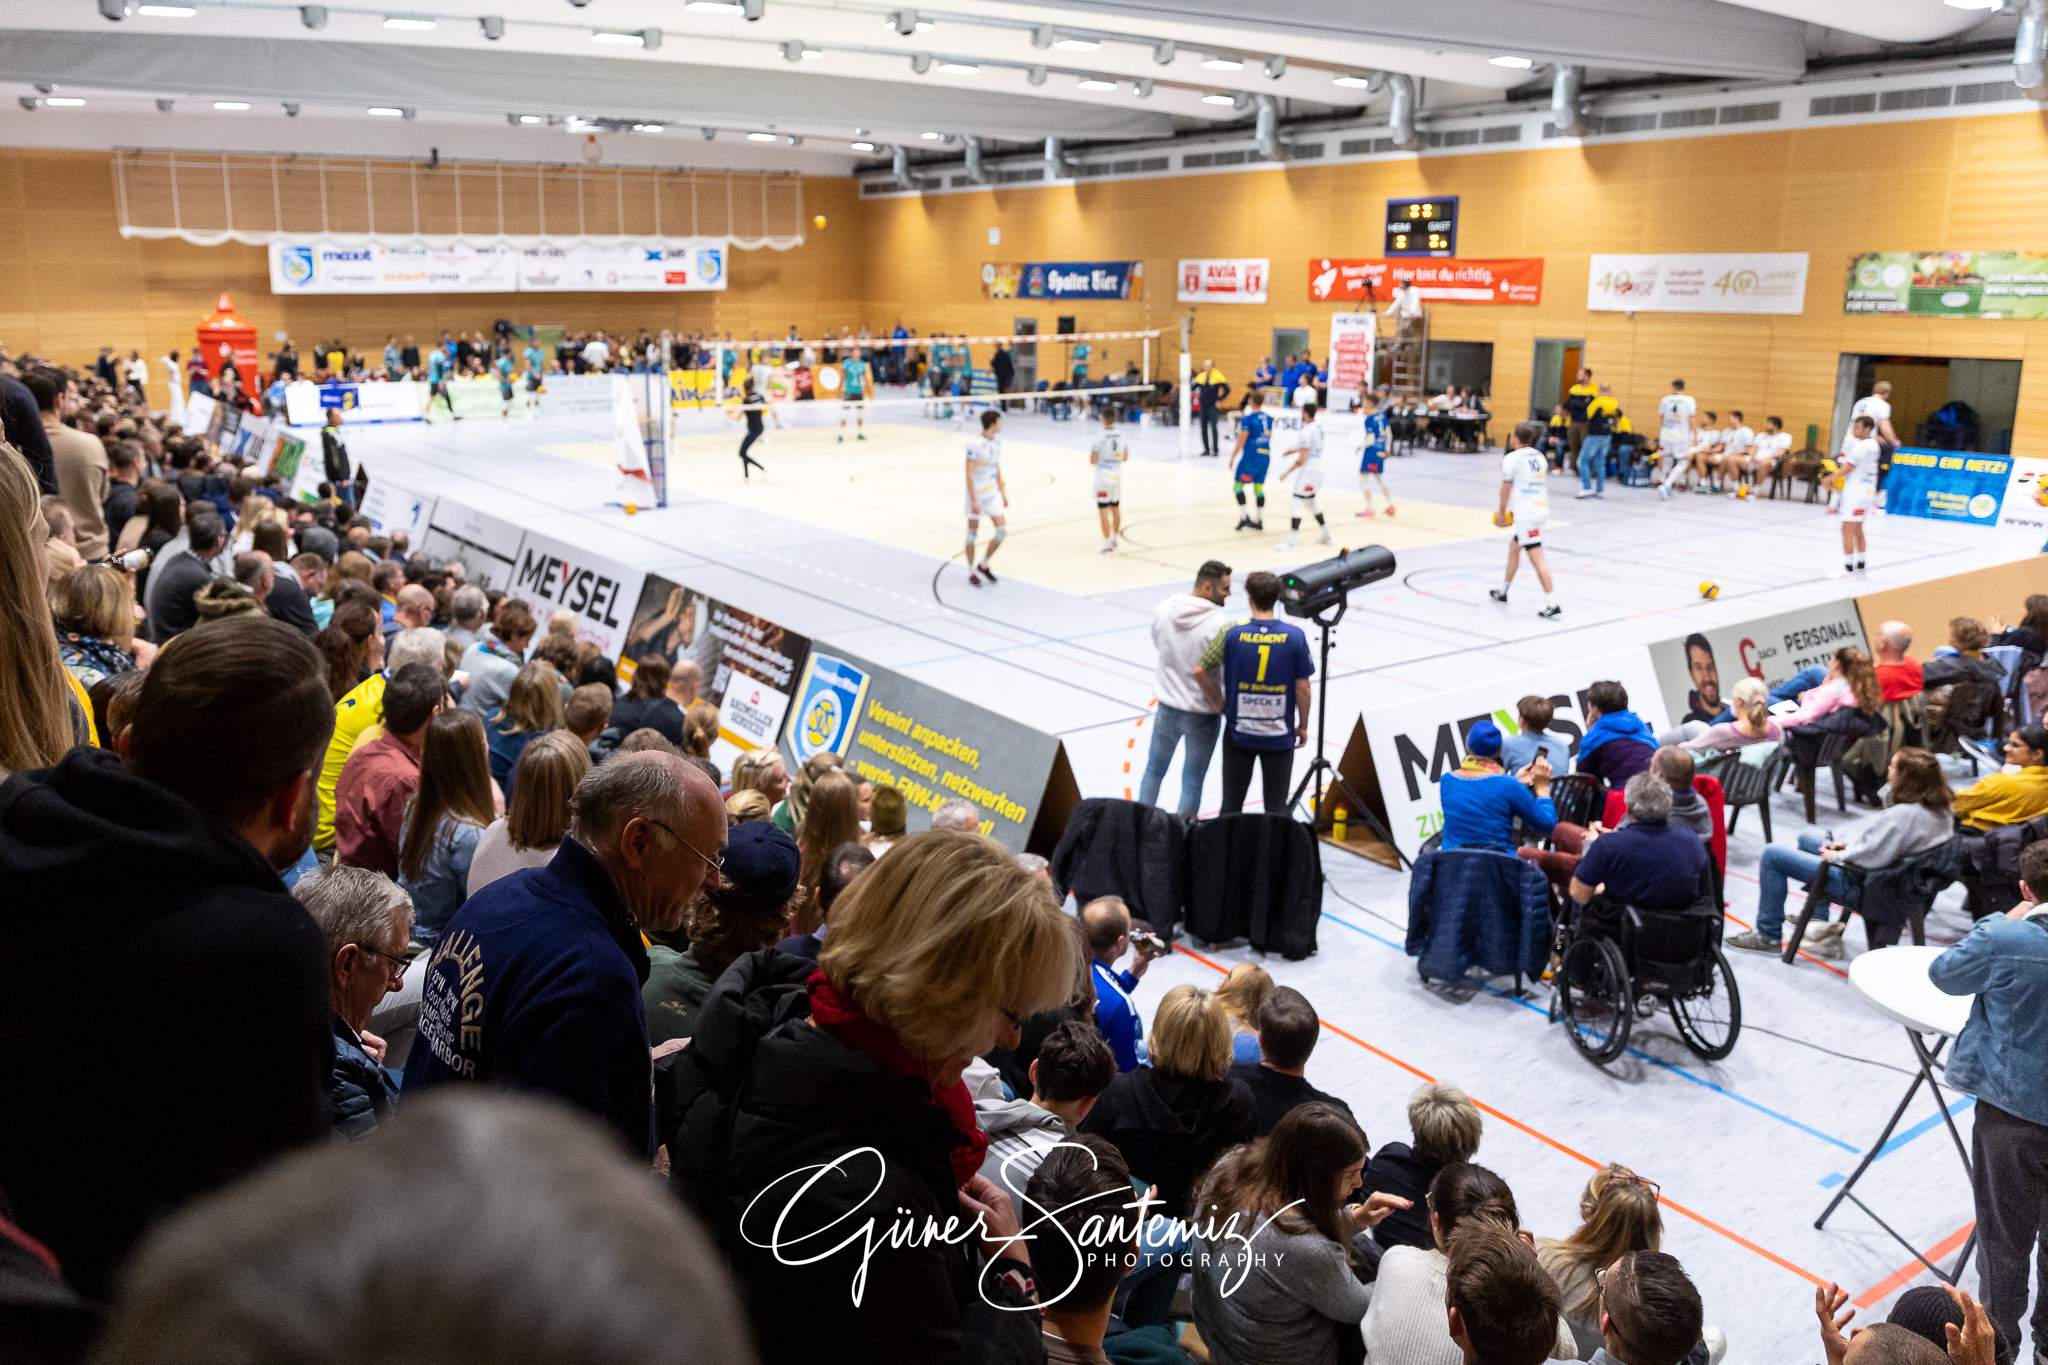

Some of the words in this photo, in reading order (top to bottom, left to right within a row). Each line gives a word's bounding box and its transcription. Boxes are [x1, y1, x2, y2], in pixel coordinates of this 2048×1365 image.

[1207, 265, 1236, 278] AVIA
[517, 548, 620, 629] MEYSEL
[1239, 632, 1288, 644] KLEMENT
[1783, 619, 1856, 653] PERSONAL
[867, 698, 913, 735] Vereint
[910, 722, 980, 770] anpacken,
[857, 729, 938, 784] unterstützen,
[940, 770, 1027, 824] netzwerken
